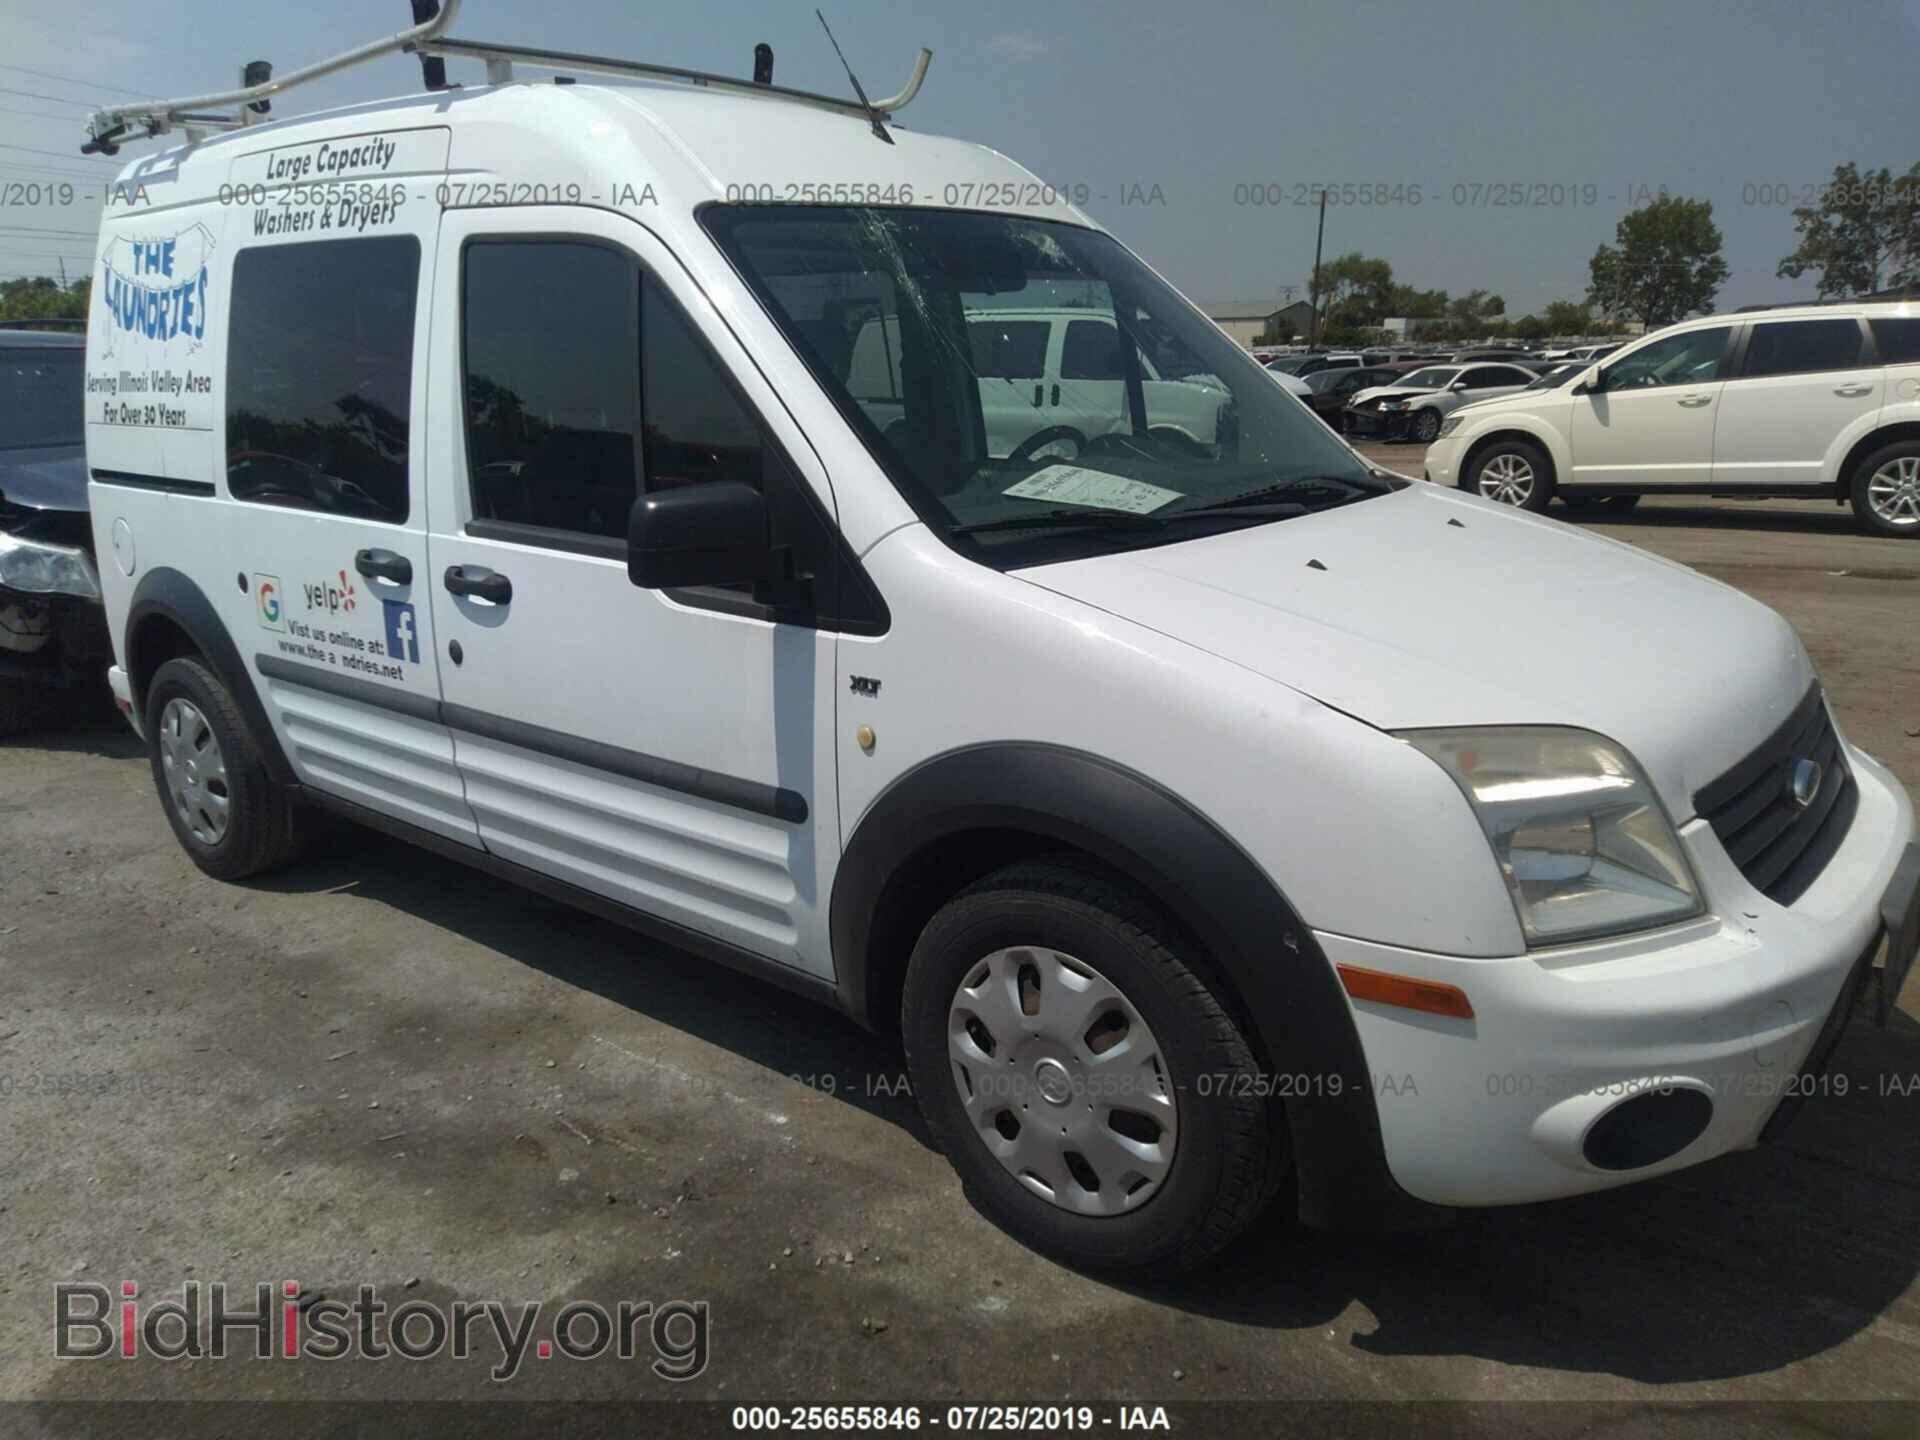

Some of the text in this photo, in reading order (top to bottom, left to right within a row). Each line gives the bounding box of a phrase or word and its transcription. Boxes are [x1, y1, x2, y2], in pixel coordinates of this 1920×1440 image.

[266, 137, 396, 181] Large Capacity
[254, 198, 397, 236] Washers & Dryers
[133, 239, 177, 279] THE
[104, 264, 208, 342] LAUNDRIES
[87, 371, 117, 397] Serving
[151, 369, 183, 397] Valley
[184, 369, 211, 393] Area
[104, 401, 186, 427] For Over 30 Years
[303, 582, 339, 616] yelp
[312, 629, 326, 642] us
[329, 632, 365, 651] online
